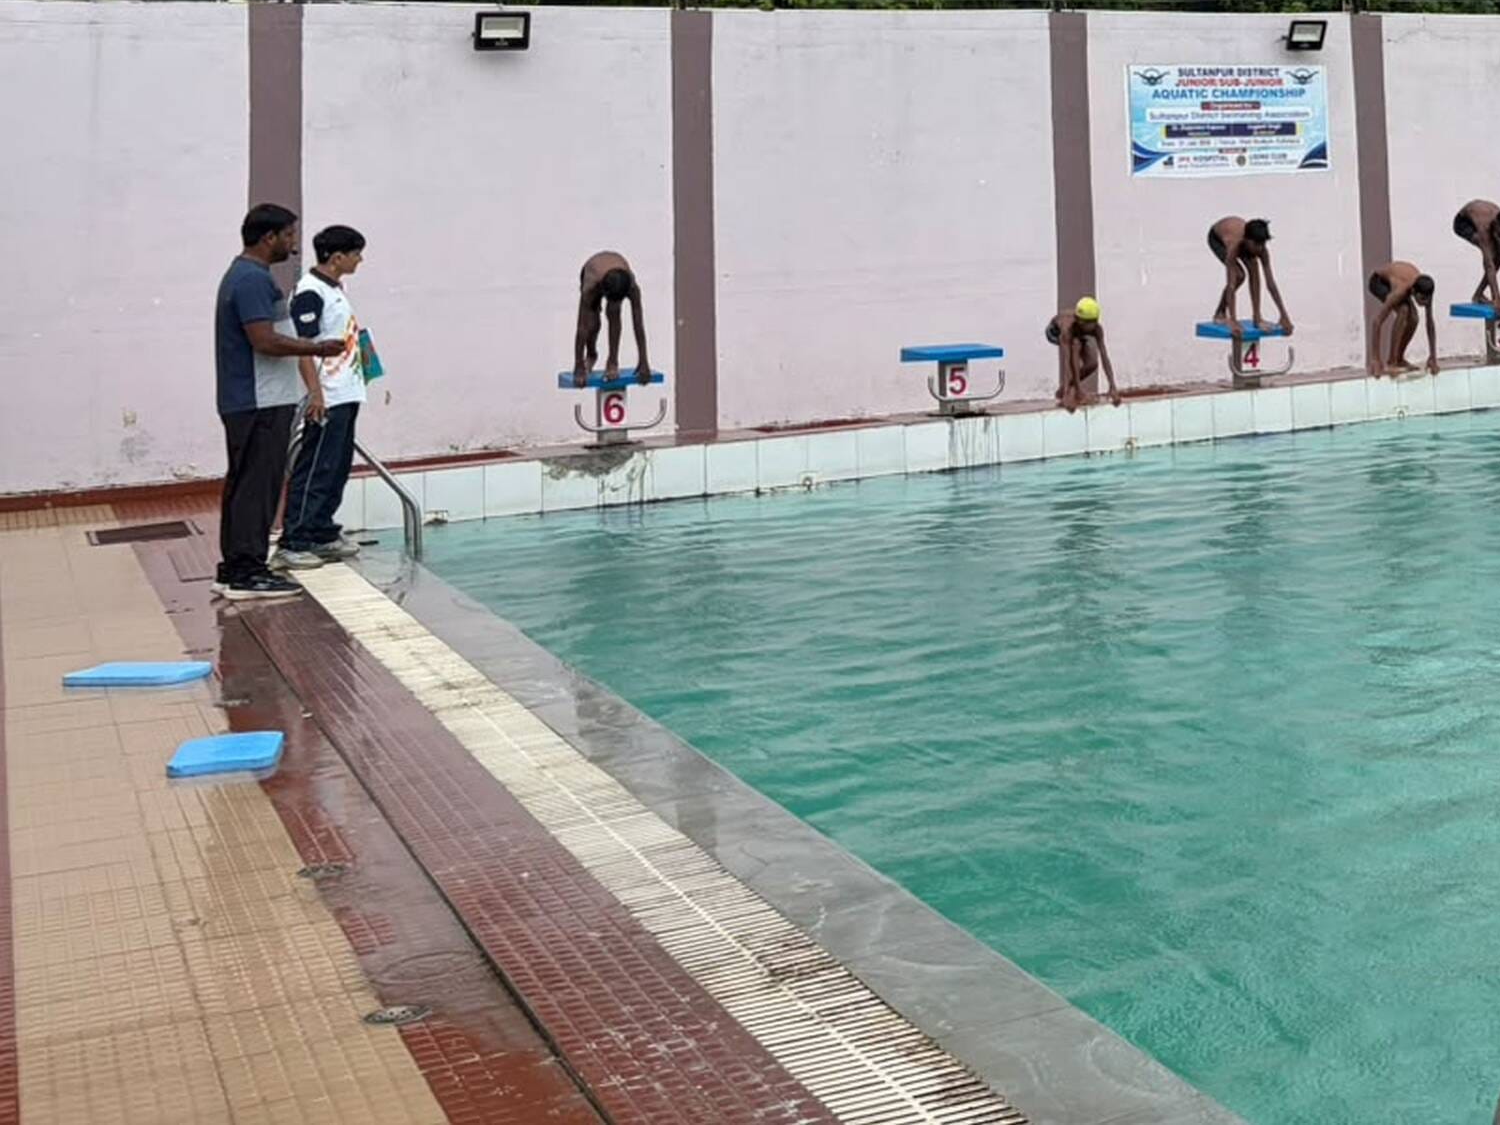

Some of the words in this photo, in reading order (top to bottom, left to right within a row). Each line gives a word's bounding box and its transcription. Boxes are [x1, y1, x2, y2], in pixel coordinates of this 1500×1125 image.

[1178, 68, 1233, 77] SULTANPUR
[1237, 68, 1279, 77] DISTRICT
[1152, 89, 1208, 100] AQUATIC
[1212, 88, 1306, 99] CHAMPIONSHIP
[1243, 342, 1260, 368] 4
[949, 366, 967, 395] 5
[603, 393, 625, 424] 6
